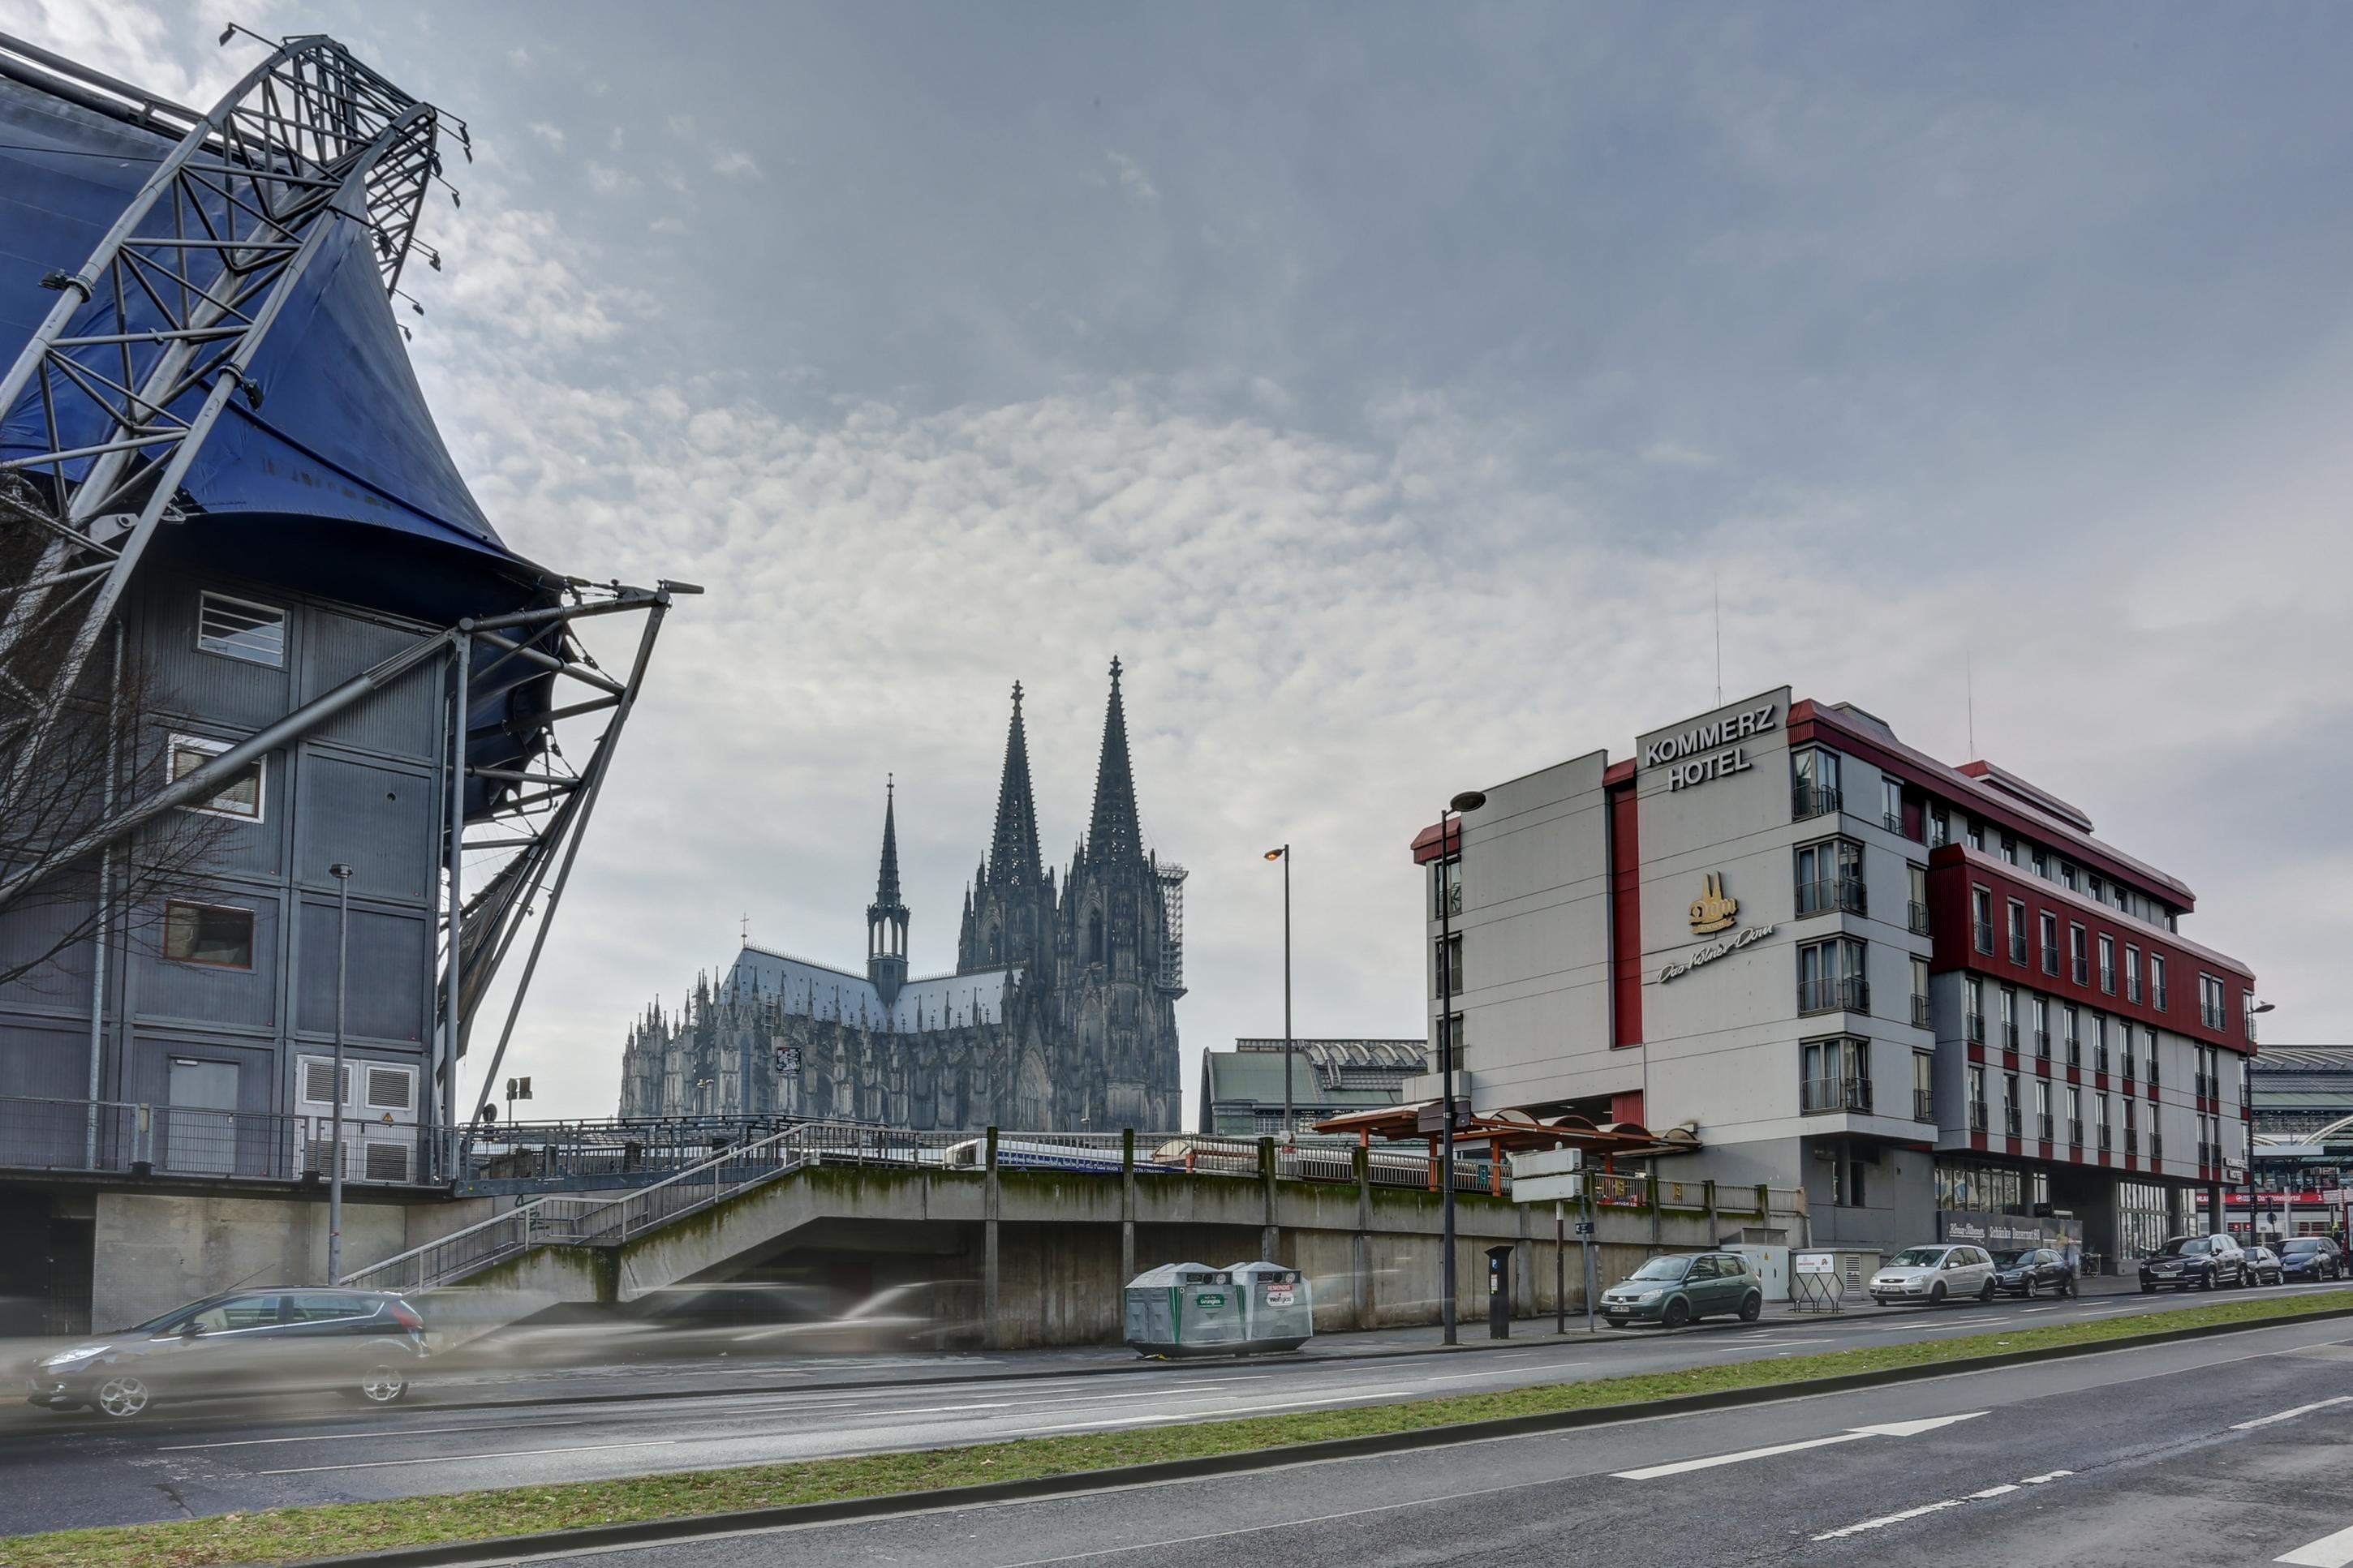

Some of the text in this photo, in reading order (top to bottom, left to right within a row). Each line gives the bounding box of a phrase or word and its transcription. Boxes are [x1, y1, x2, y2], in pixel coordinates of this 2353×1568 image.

[1645, 704, 1775, 767] KOMMERZ
[1668, 748, 1751, 791] HOTEL
[1688, 898, 1738, 925] Dom
[1688, 943, 1734, 969] Kölner
[1735, 925, 1774, 948] Dom
[1492, 1259, 1497, 1268] P
